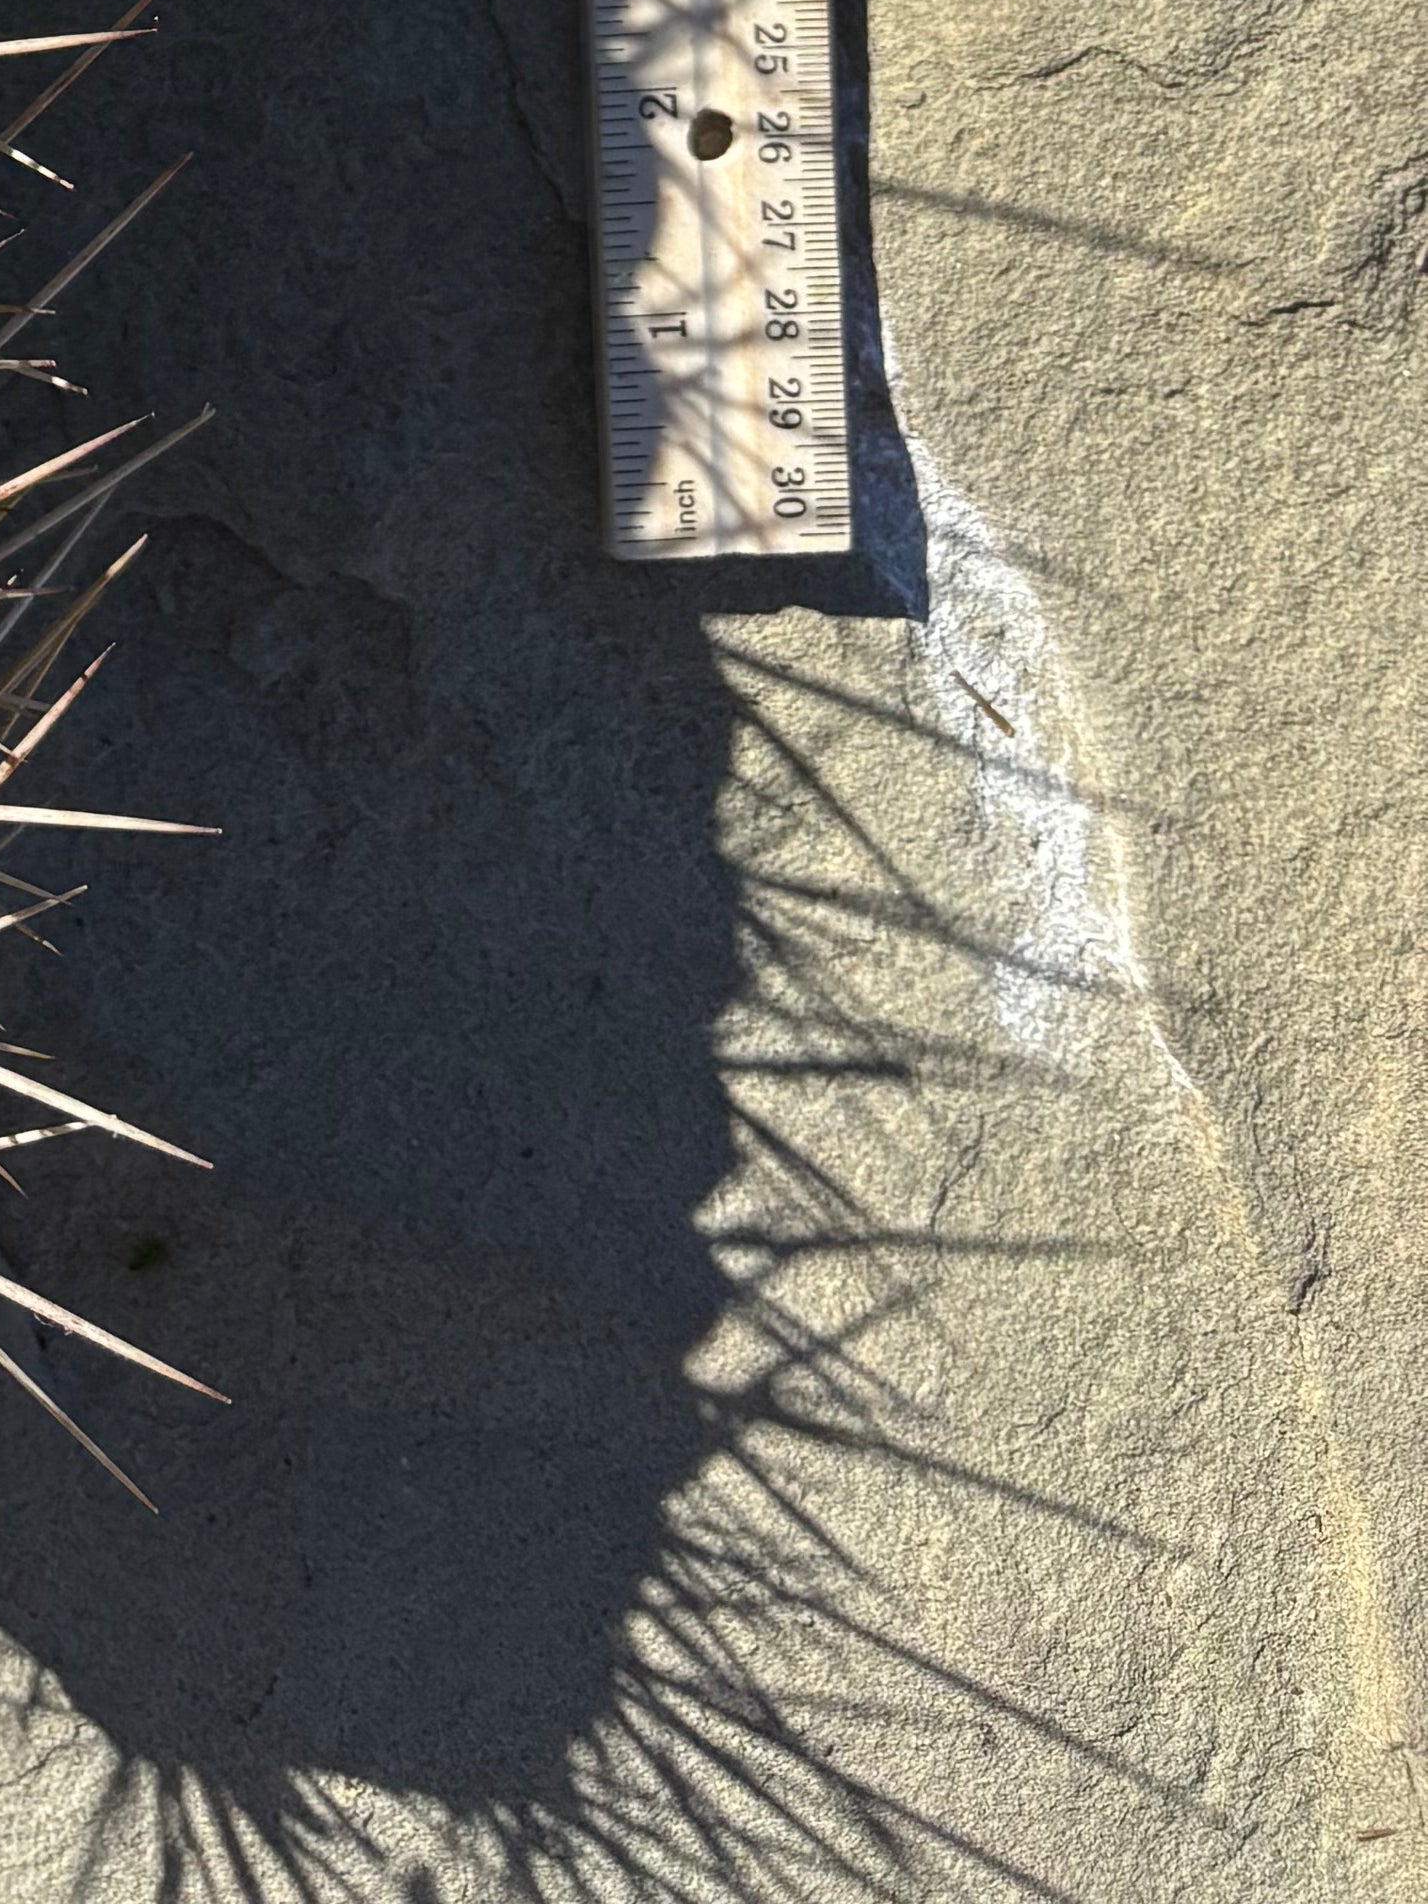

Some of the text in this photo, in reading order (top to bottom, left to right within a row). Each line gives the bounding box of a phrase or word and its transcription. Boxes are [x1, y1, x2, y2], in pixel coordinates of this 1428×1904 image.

[754, 23, 789, 75] 25
[638, 92, 678, 121] 2
[757, 110, 792, 165] 26
[761, 199, 796, 252] 27
[650, 317, 687, 339] 1
[764, 288, 800, 341] 28
[768, 376, 803, 430] 29
[675, 478, 696, 533] inch
[770, 465, 807, 518] 30
